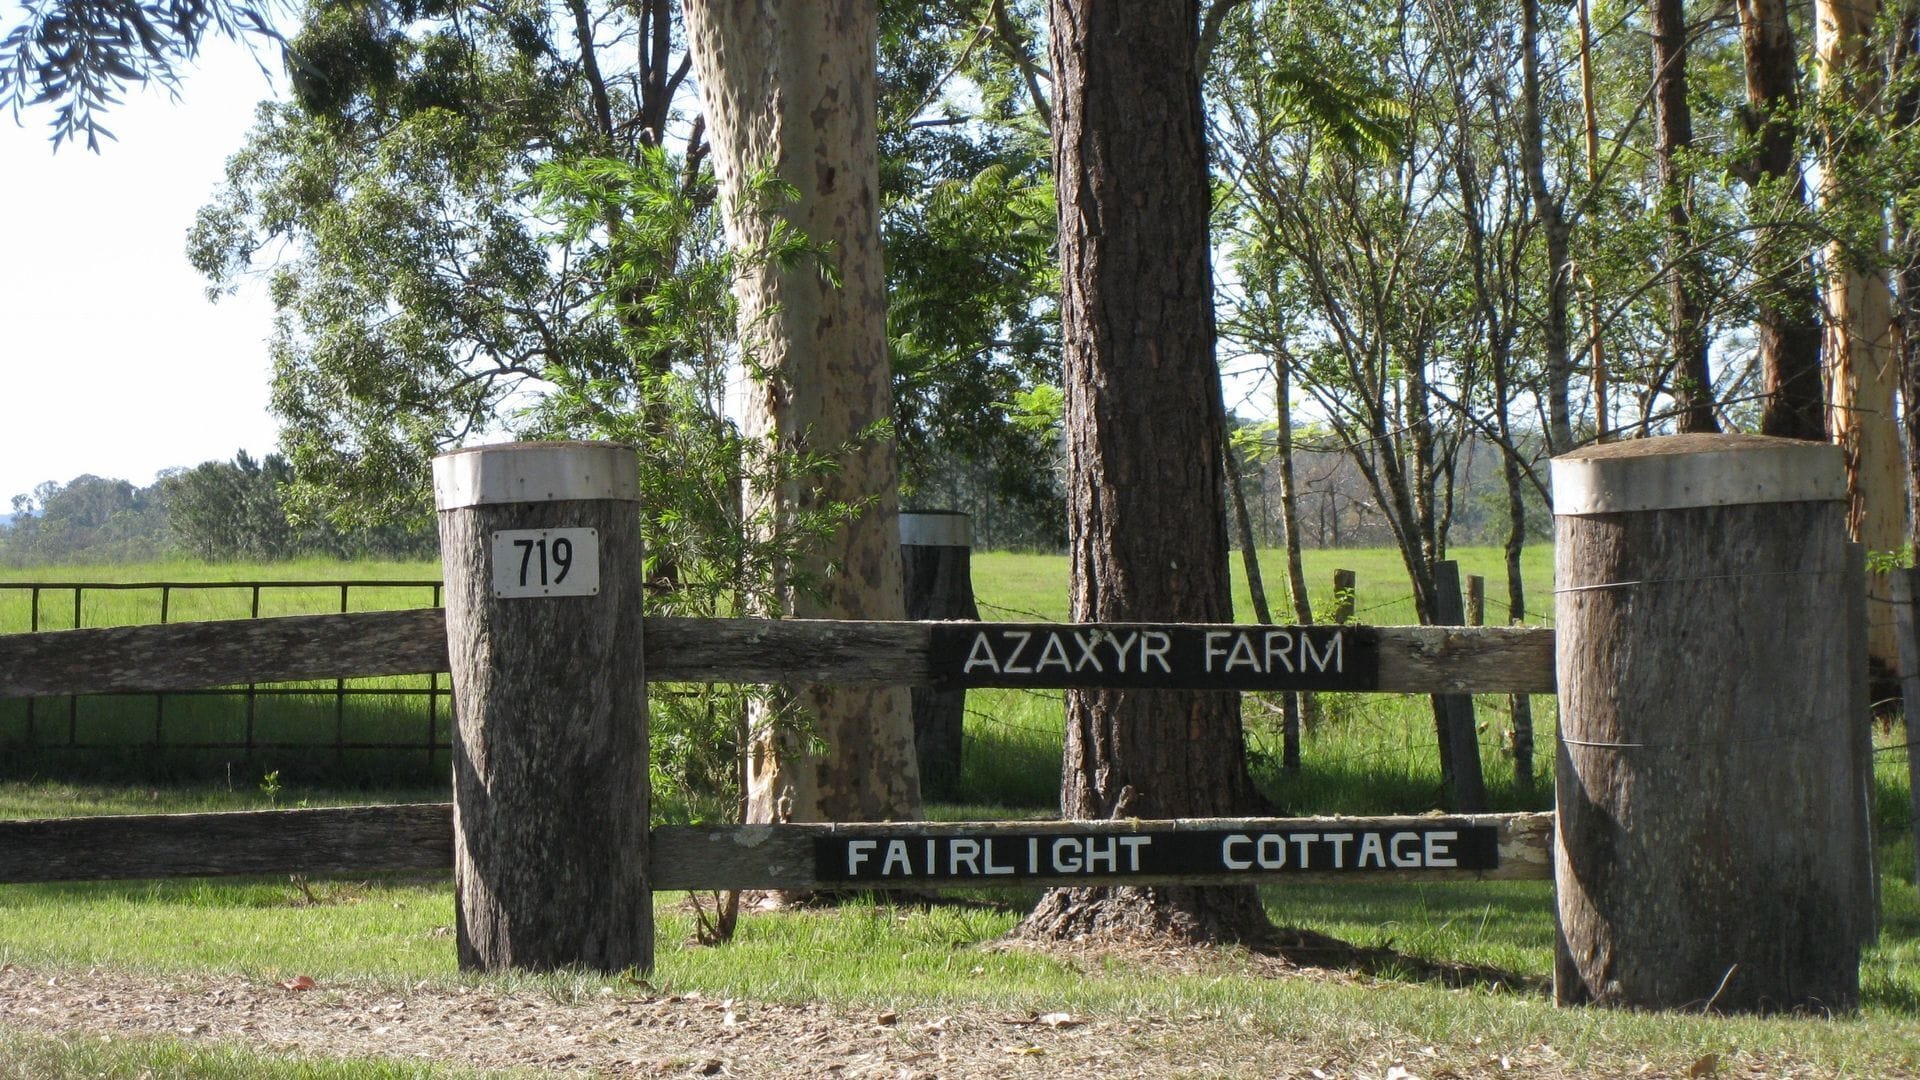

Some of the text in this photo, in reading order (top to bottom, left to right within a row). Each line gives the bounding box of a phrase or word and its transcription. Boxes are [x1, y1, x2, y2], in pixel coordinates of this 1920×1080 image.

[513, 538, 573, 587] 719
[963, 629, 1343, 674] AZAXYR FARM
[848, 831, 1458, 876] FAIRLIGHT COTTAGE
